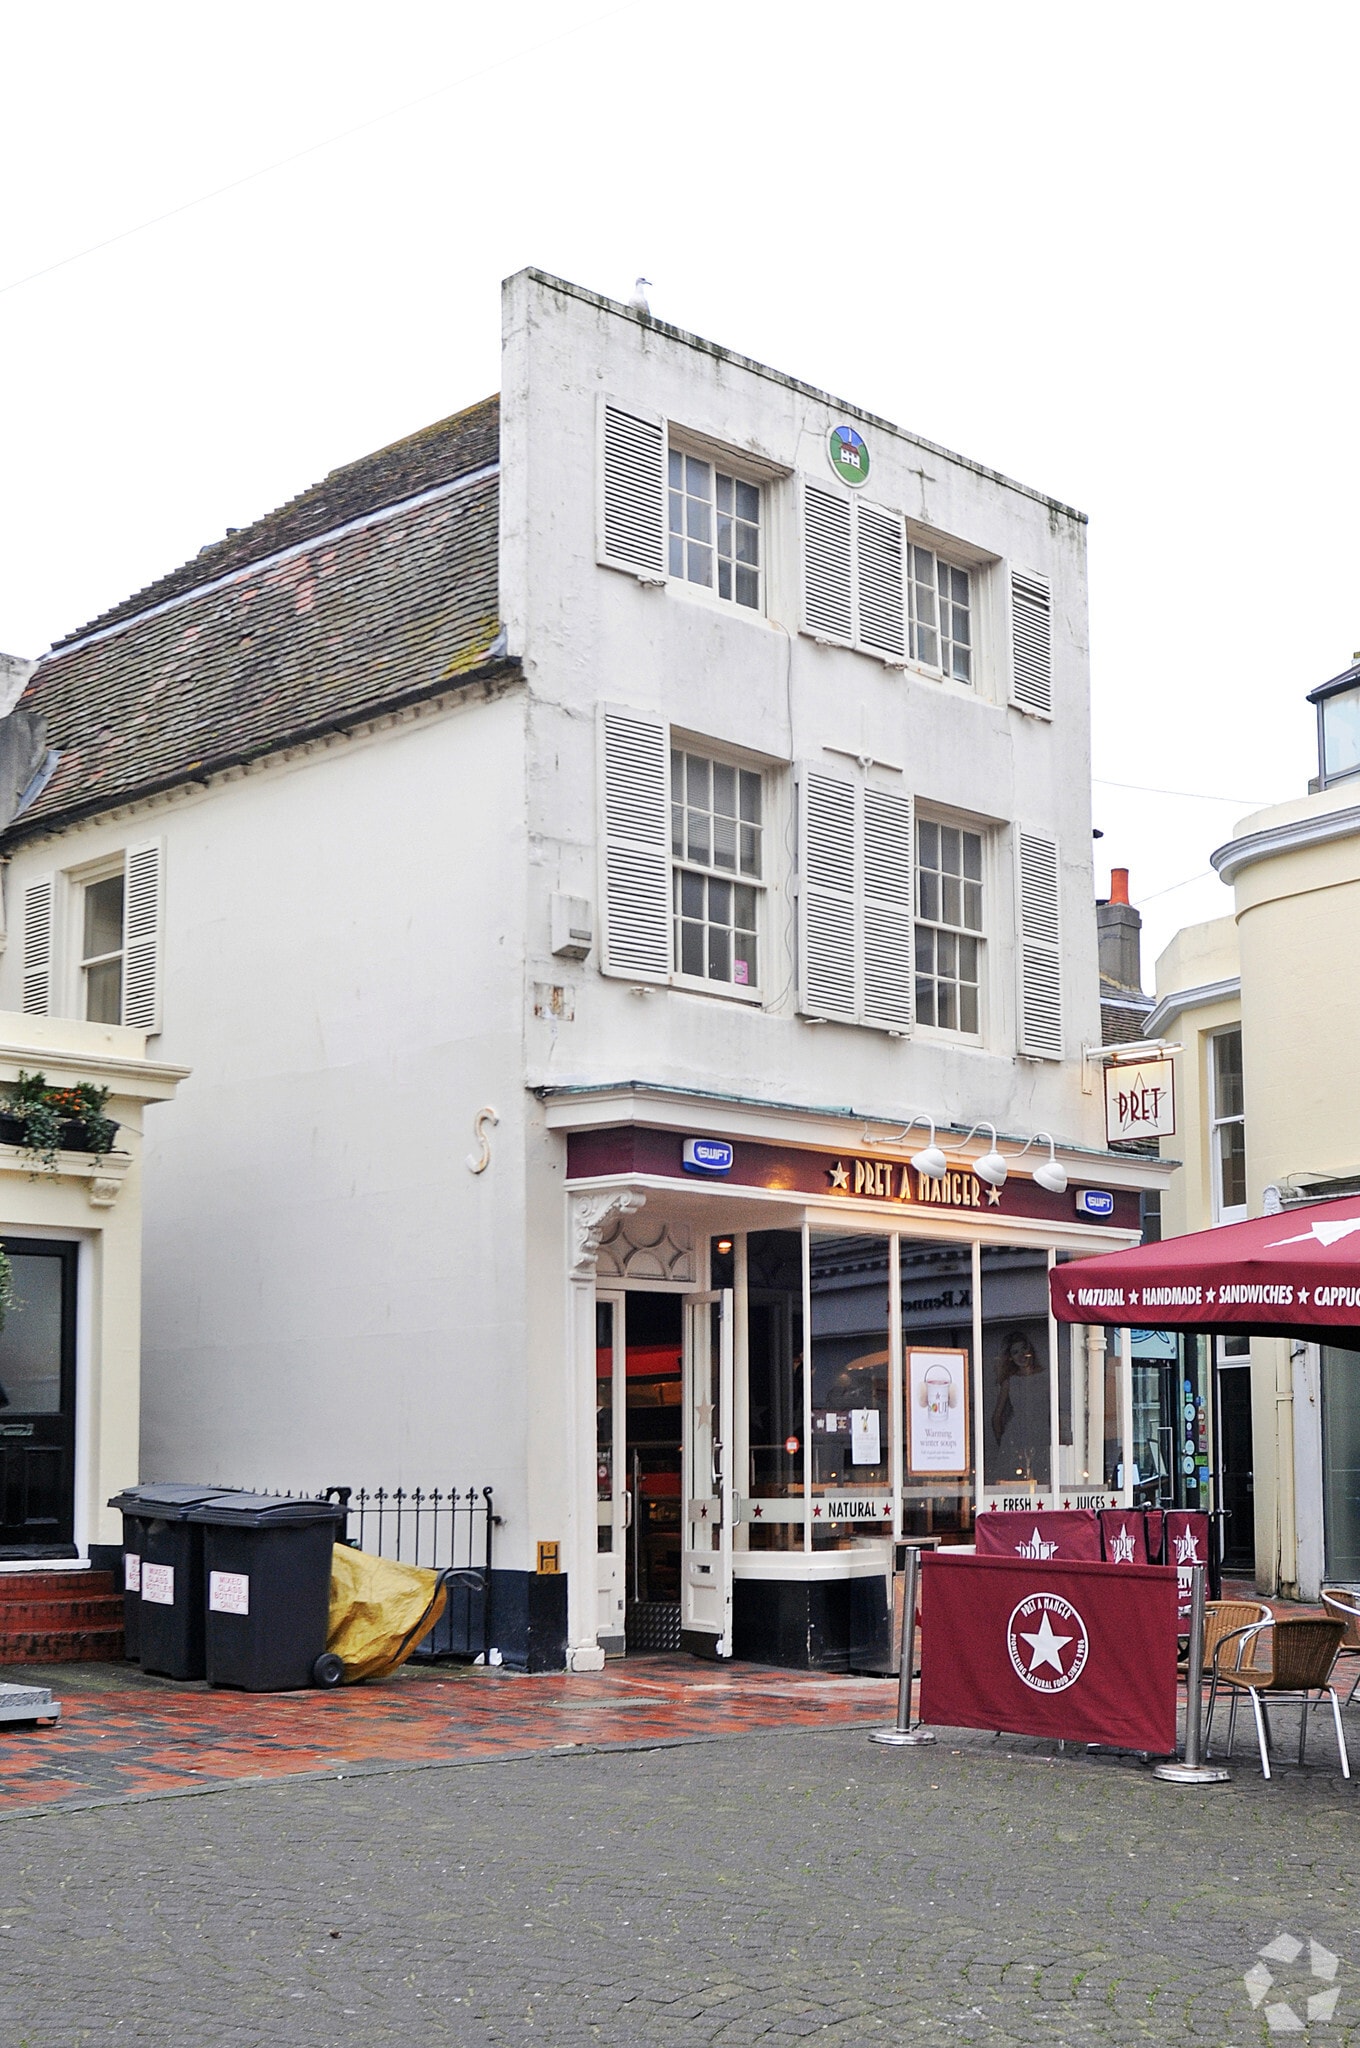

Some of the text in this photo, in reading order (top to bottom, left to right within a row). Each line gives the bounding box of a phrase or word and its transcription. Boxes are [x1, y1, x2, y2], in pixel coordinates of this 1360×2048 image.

[1119, 1087, 1161, 1123] PRET
[697, 1146, 730, 1162] SWIFT
[855, 1159, 981, 1207] PRET A MANGER
[1087, 1195, 1111, 1209] SWIFT
[1078, 1287, 1125, 1306] NATURAL
[1142, 1286, 1202, 1305] HANDMADE
[1218, 1284, 1293, 1304] SANDWICHES
[925, 1428, 952, 1438] Warming
[920, 1439, 957, 1449] winter soups
[828, 1502, 877, 1518] NATURAL
[1003, 1495, 1105, 1511] FRESH JUICES
[1111, 1535, 1135, 1558] PRET
[540, 1544, 558, 1571] H
[218, 1584, 243, 1594] GLASS
[219, 1576, 242, 1586] MIXED
[214, 1591, 247, 1603] BOTTLES
[1020, 1597, 1072, 1620] PRET A MANGER
[1026, 1672, 1052, 1689] NATURAL
[1053, 1674, 1070, 1688] FOOD
[1067, 1659, 1082, 1678] SINCE
[1075, 1639, 1086, 1659] 1986
